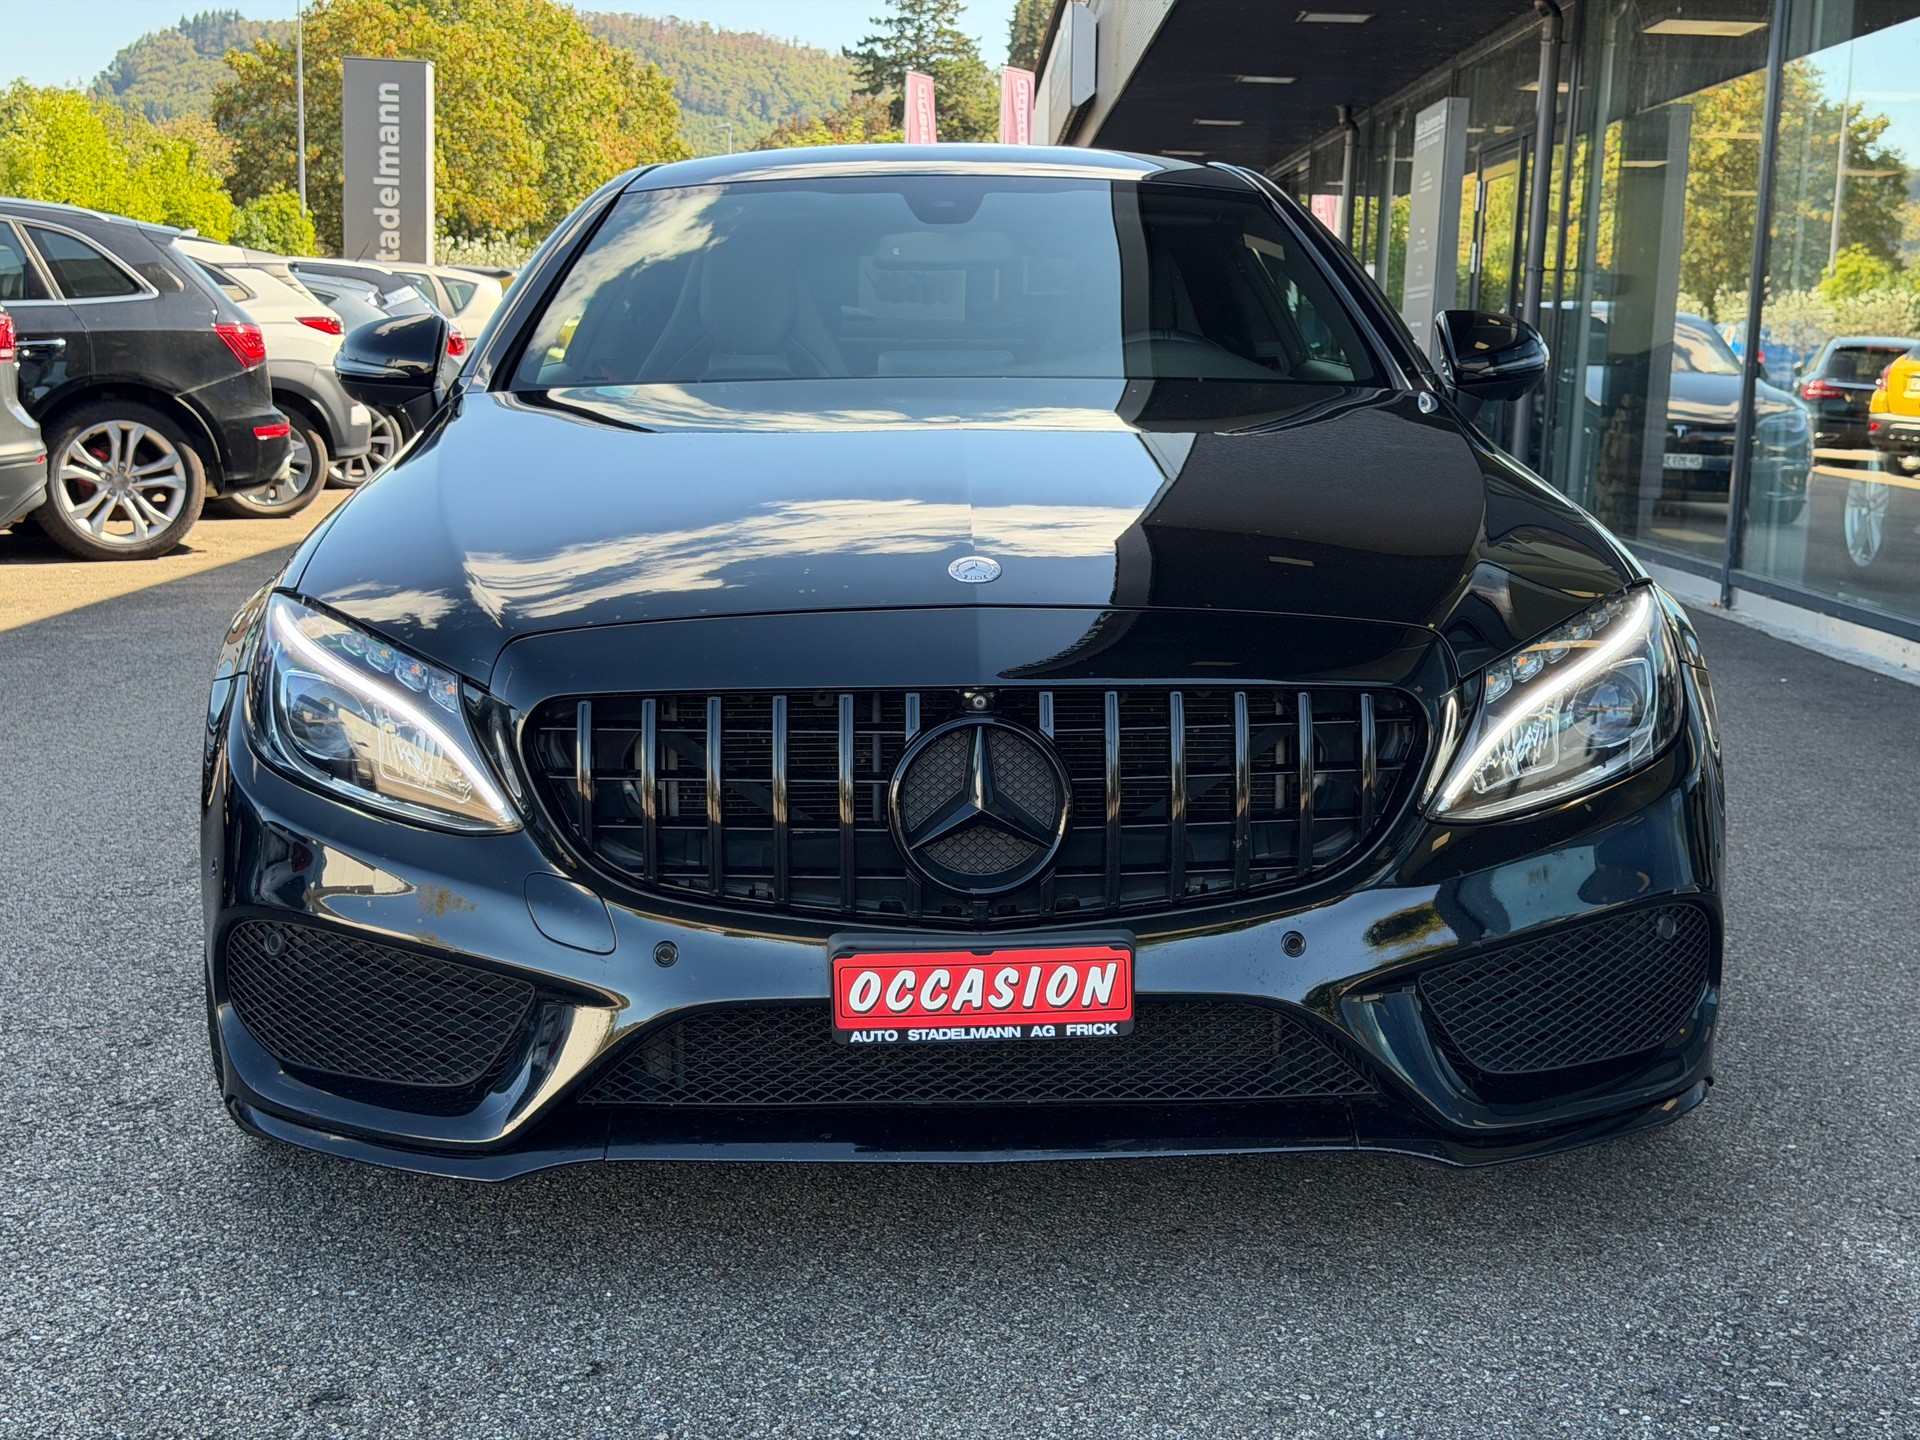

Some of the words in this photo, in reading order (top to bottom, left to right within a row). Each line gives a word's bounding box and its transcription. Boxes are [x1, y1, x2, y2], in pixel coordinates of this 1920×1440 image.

[848, 963, 1118, 1014] OCCASION
[850, 1030, 899, 1043] AUTO
[907, 1026, 1021, 1041] STADELMANN
[1030, 1024, 1056, 1038] AG
[1066, 1022, 1118, 1037] FRICK
